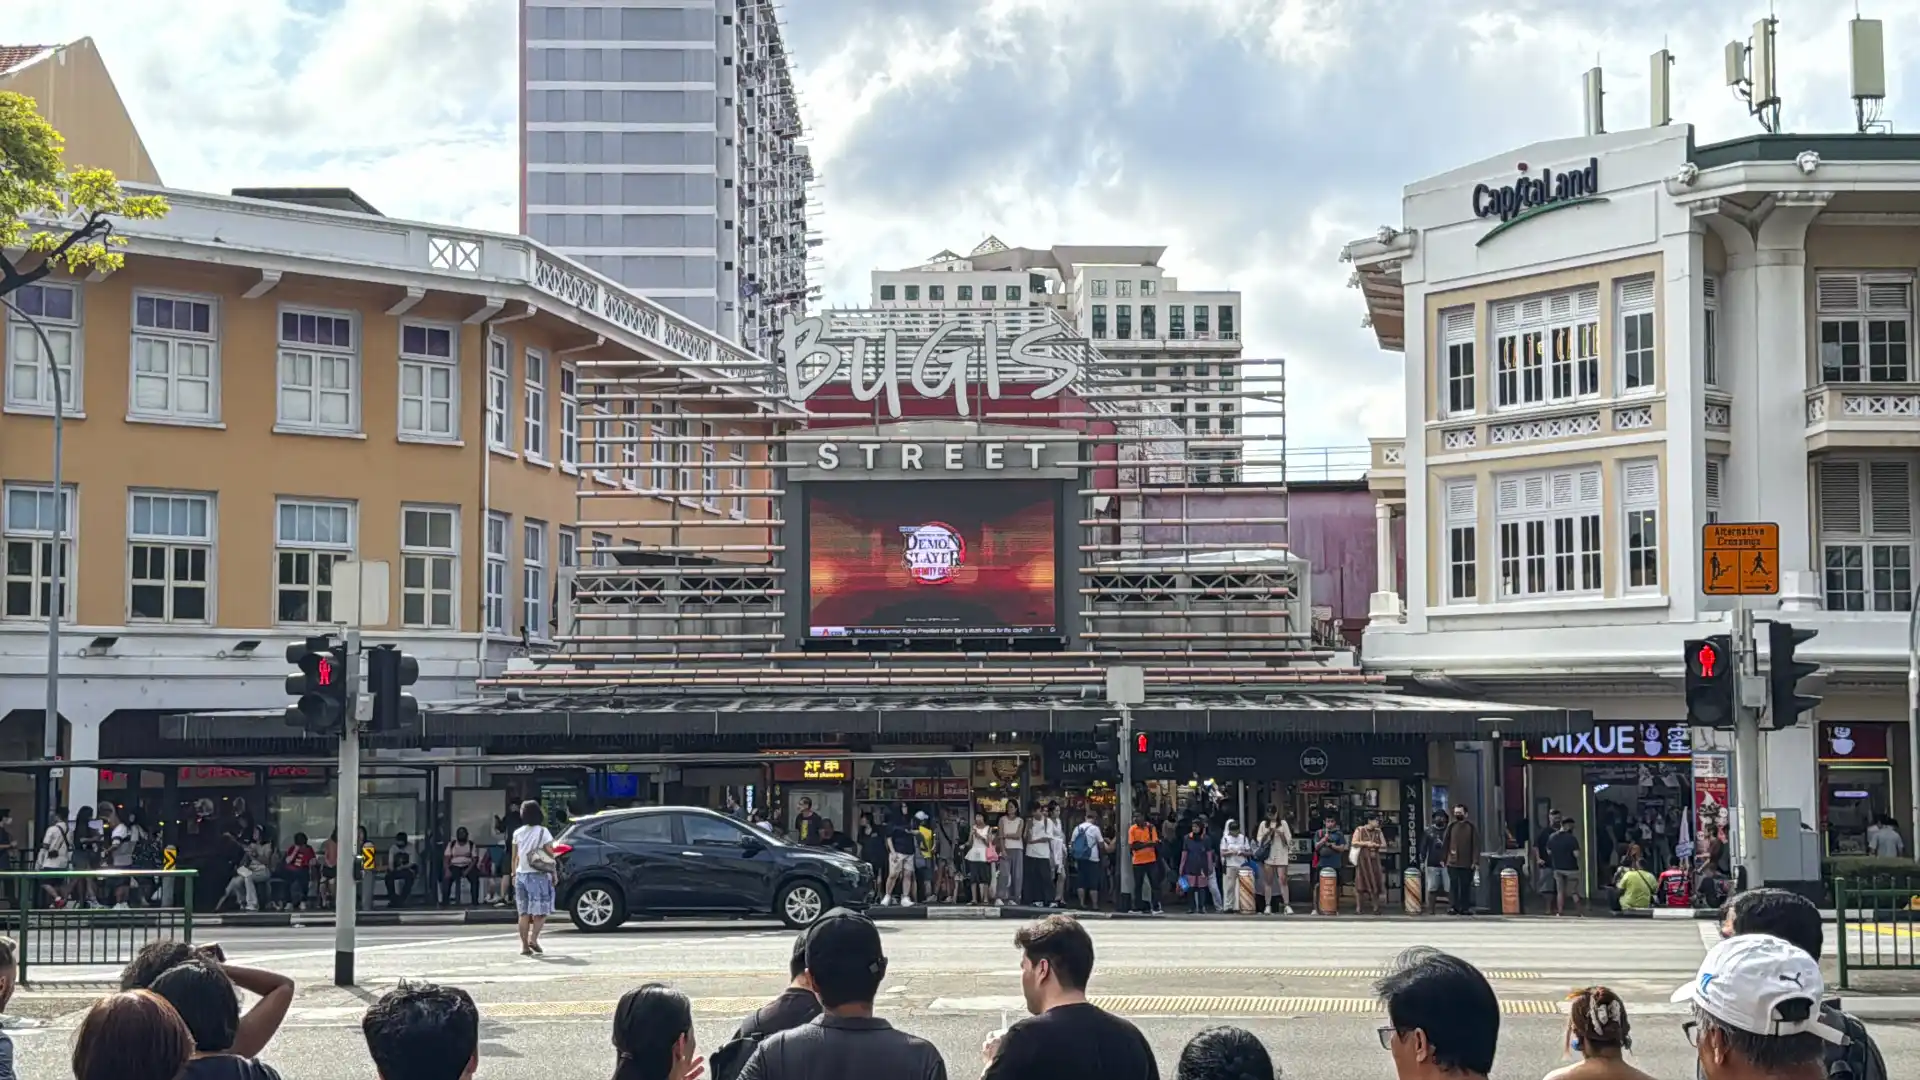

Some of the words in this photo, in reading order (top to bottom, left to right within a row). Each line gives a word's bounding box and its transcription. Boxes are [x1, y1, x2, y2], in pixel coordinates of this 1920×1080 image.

[1473, 157, 1598, 222] CapitaLand
[817, 443, 1047, 470] STREET
[1714, 526, 1765, 536] Alternative
[903, 533, 961, 551] DEMON
[903, 550, 962, 568] SLAYER
[1542, 726, 1635, 754] MIXUE
[1058, 750, 1071, 760] 24
[1217, 757, 1256, 767] SEIKO
[1372, 756, 1411, 766] SEIKO
[1062, 763, 1086, 773] LINK
[1408, 804, 1418, 864] PROSPEX
